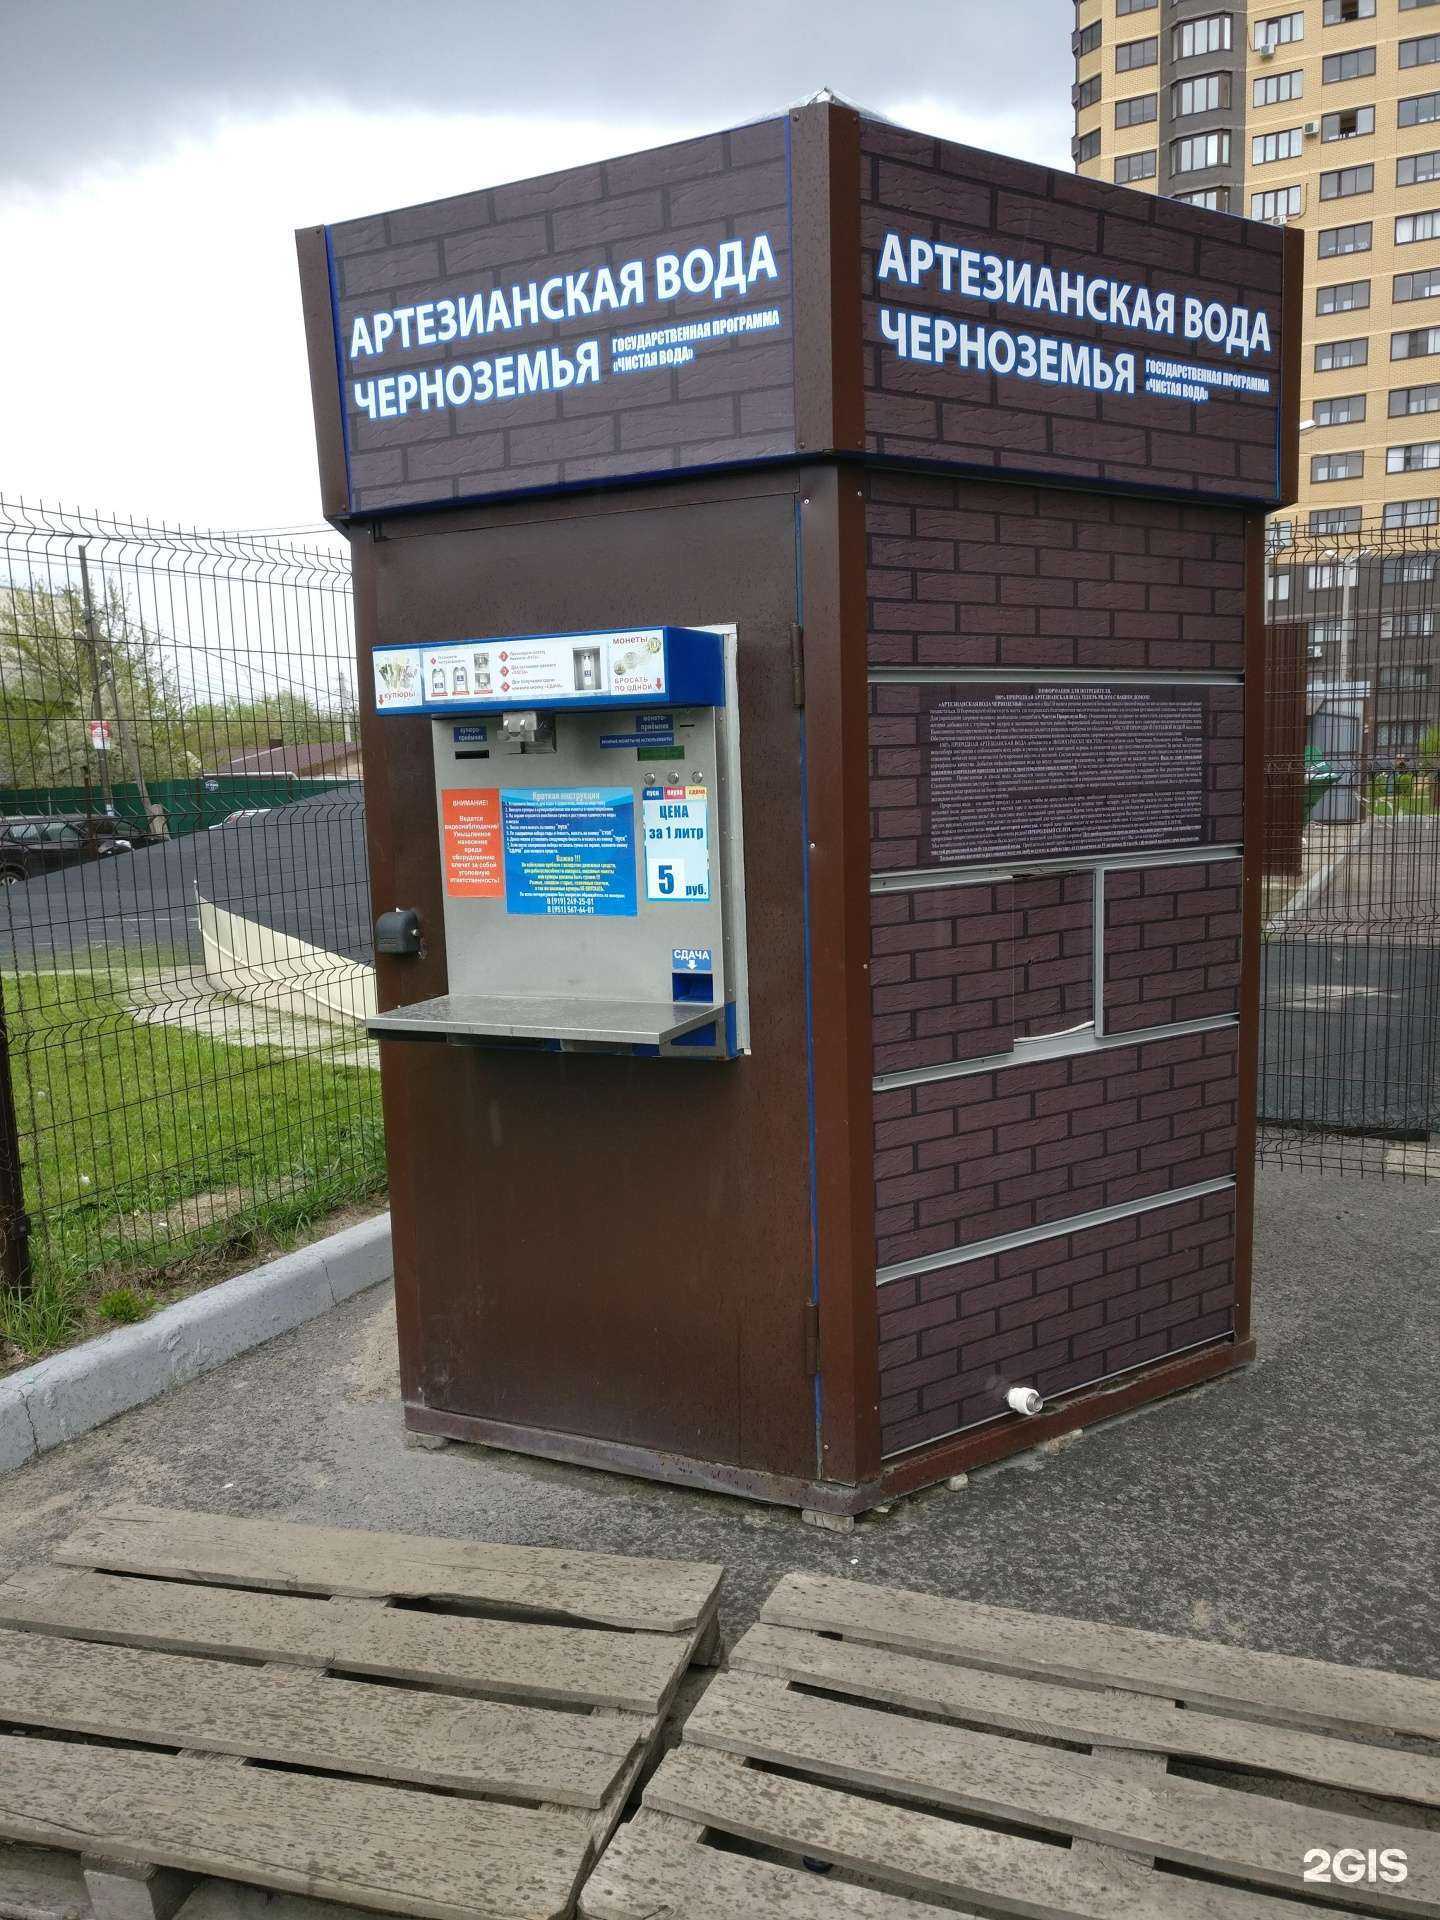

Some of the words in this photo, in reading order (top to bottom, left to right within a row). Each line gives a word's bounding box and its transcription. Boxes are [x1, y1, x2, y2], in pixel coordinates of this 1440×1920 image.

[350, 260, 644, 358] АРТЕЗИАНСКАЯ
[656, 235, 778, 299] ВОДА
[878, 233, 1175, 333] АРТЕЗИАНСКАЯ
[1184, 297, 1271, 357] ВОДА
[612, 321, 711, 353] ГОСУДАРСТВЕННАЯ
[712, 310, 780, 336] ПРОГРАММА
[613, 351, 658, 372] «ЧИСТАЯ
[659, 346, 693, 365] ВОДА»
[880, 309, 1135, 394] ЧЕРНОЗЕМЬЯ
[354, 340, 601, 420] ЧЕРНОЗЕМЬЯ
[1145, 359, 1222, 386] ГОСУДАРСТВЕННАЯ
[1222, 372, 1270, 393] ПРОГРАММА
[1145, 378, 1182, 396] «ЧИСТАЯ
[613, 636, 648, 645] монеты
[626, 683, 653, 691] ОДНОЙ
[659, 804, 689, 820] ЦЕНА
[649, 828, 663, 840] за
[666, 826, 671, 839] 1
[674, 827, 704, 840] литр
[658, 864, 675, 895] 5
[685, 884, 707, 896] руб.
[673, 949, 710, 960] СДАЧА
